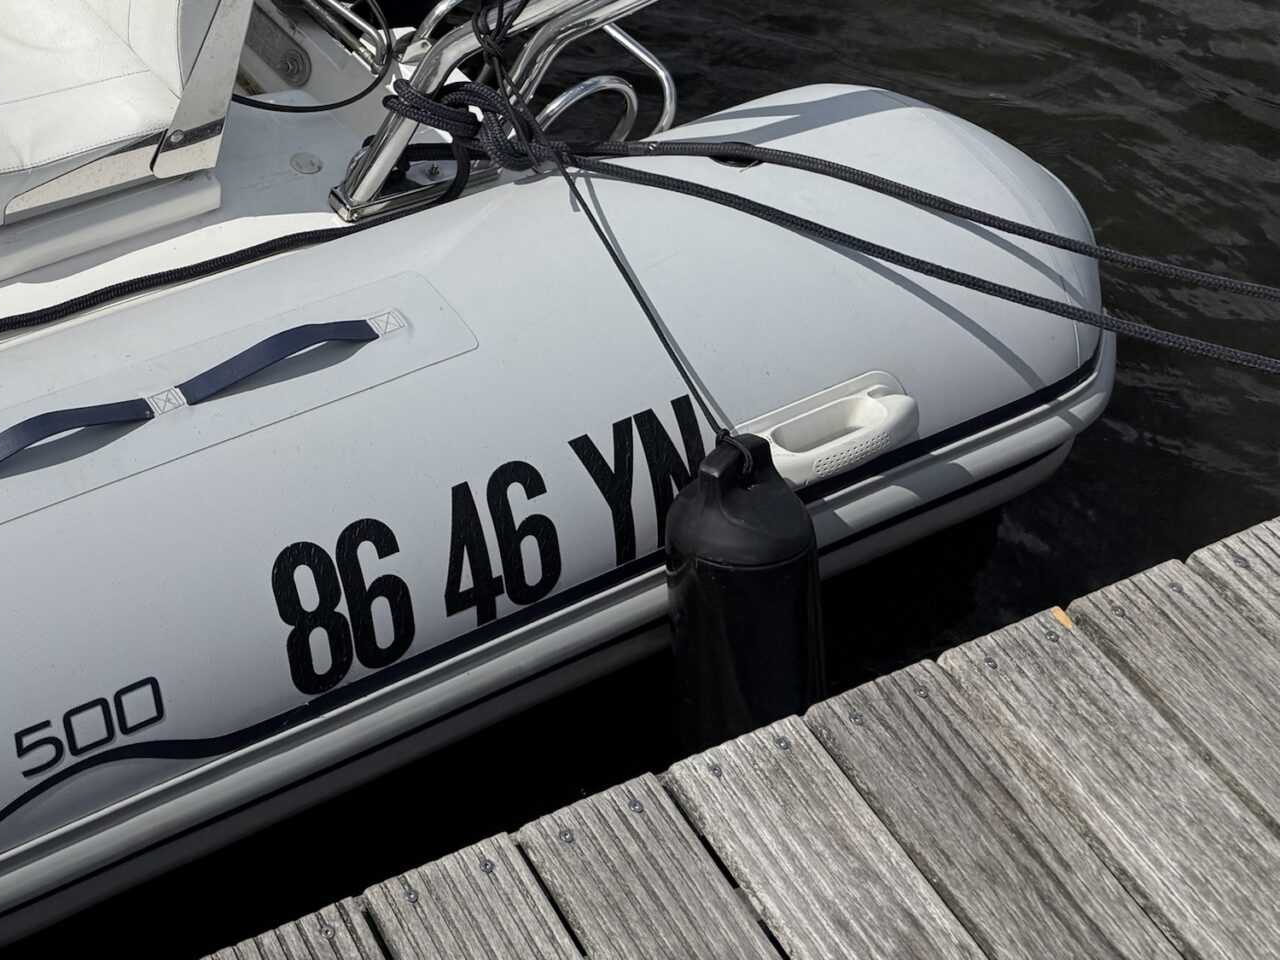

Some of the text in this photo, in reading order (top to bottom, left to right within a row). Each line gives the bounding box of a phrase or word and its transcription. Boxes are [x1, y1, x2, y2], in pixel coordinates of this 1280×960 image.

[271, 393, 708, 695] 86 46 YN
[14, 677, 164, 778] 500
